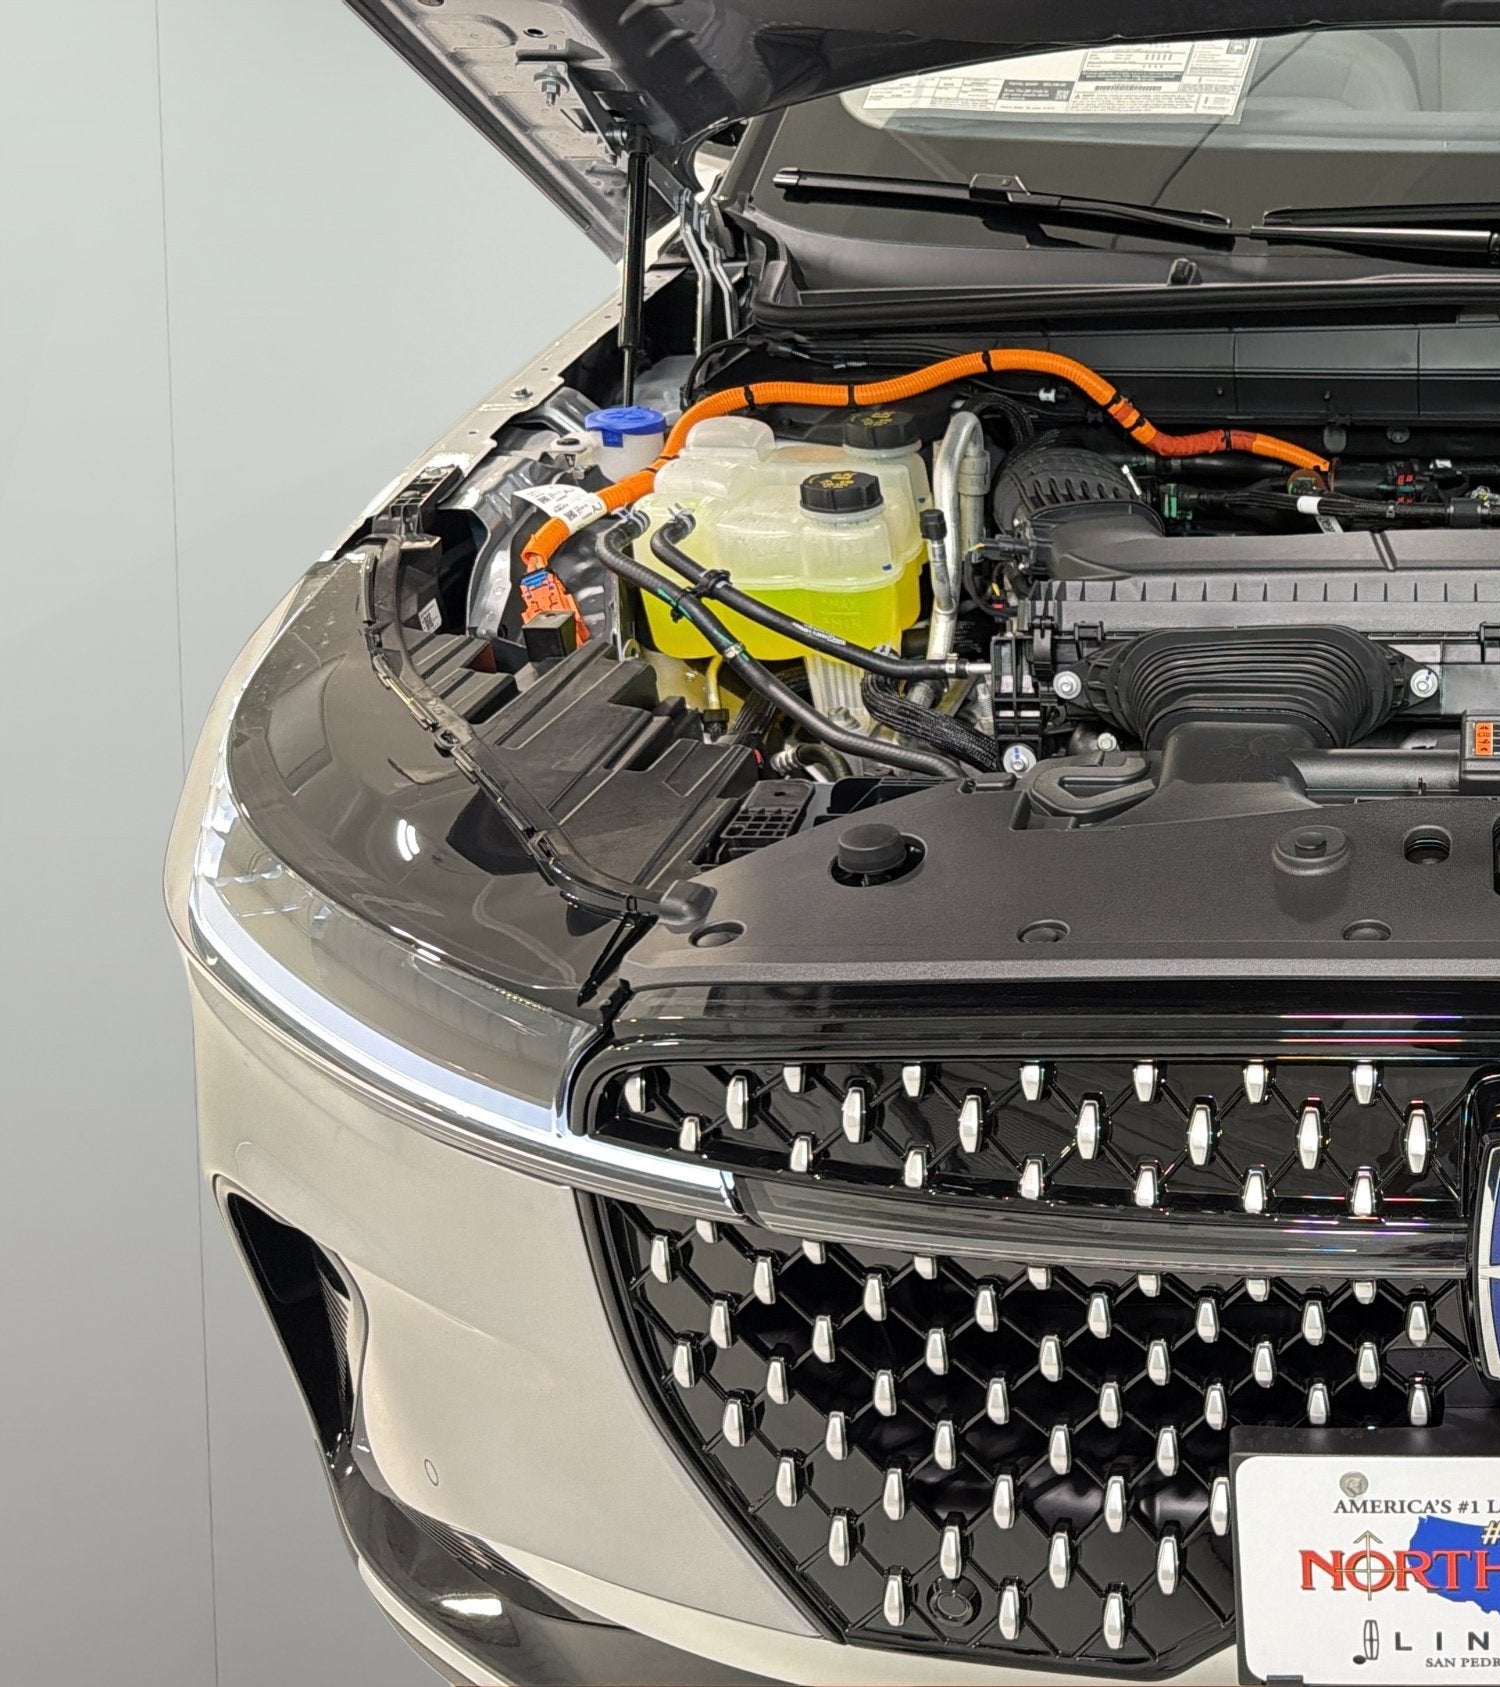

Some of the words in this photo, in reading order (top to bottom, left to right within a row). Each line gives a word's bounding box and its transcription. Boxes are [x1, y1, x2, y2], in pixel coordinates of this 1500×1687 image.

[1333, 1499, 1452, 1514] AMERICA'S
[1457, 1500, 1480, 1514] #1
[1425, 1656, 1456, 1668] SAN
